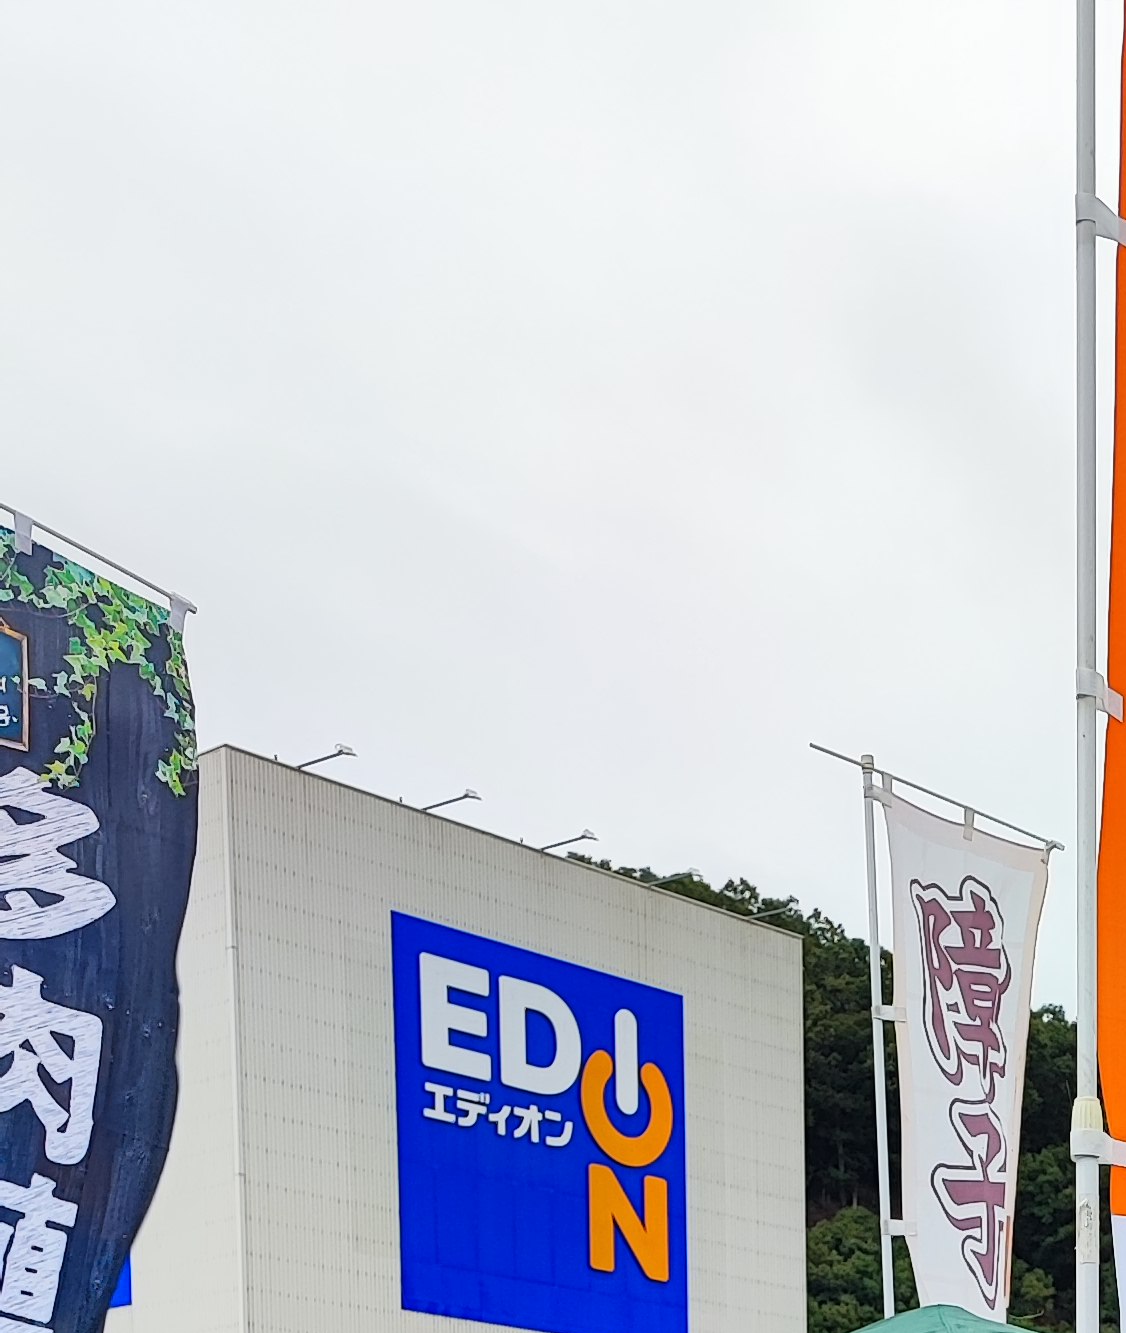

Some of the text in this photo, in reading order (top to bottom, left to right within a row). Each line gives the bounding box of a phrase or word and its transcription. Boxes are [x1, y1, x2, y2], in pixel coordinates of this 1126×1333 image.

[418, 951, 673, 1283] EDION
[422, 1082, 572, 1148] エディオン
